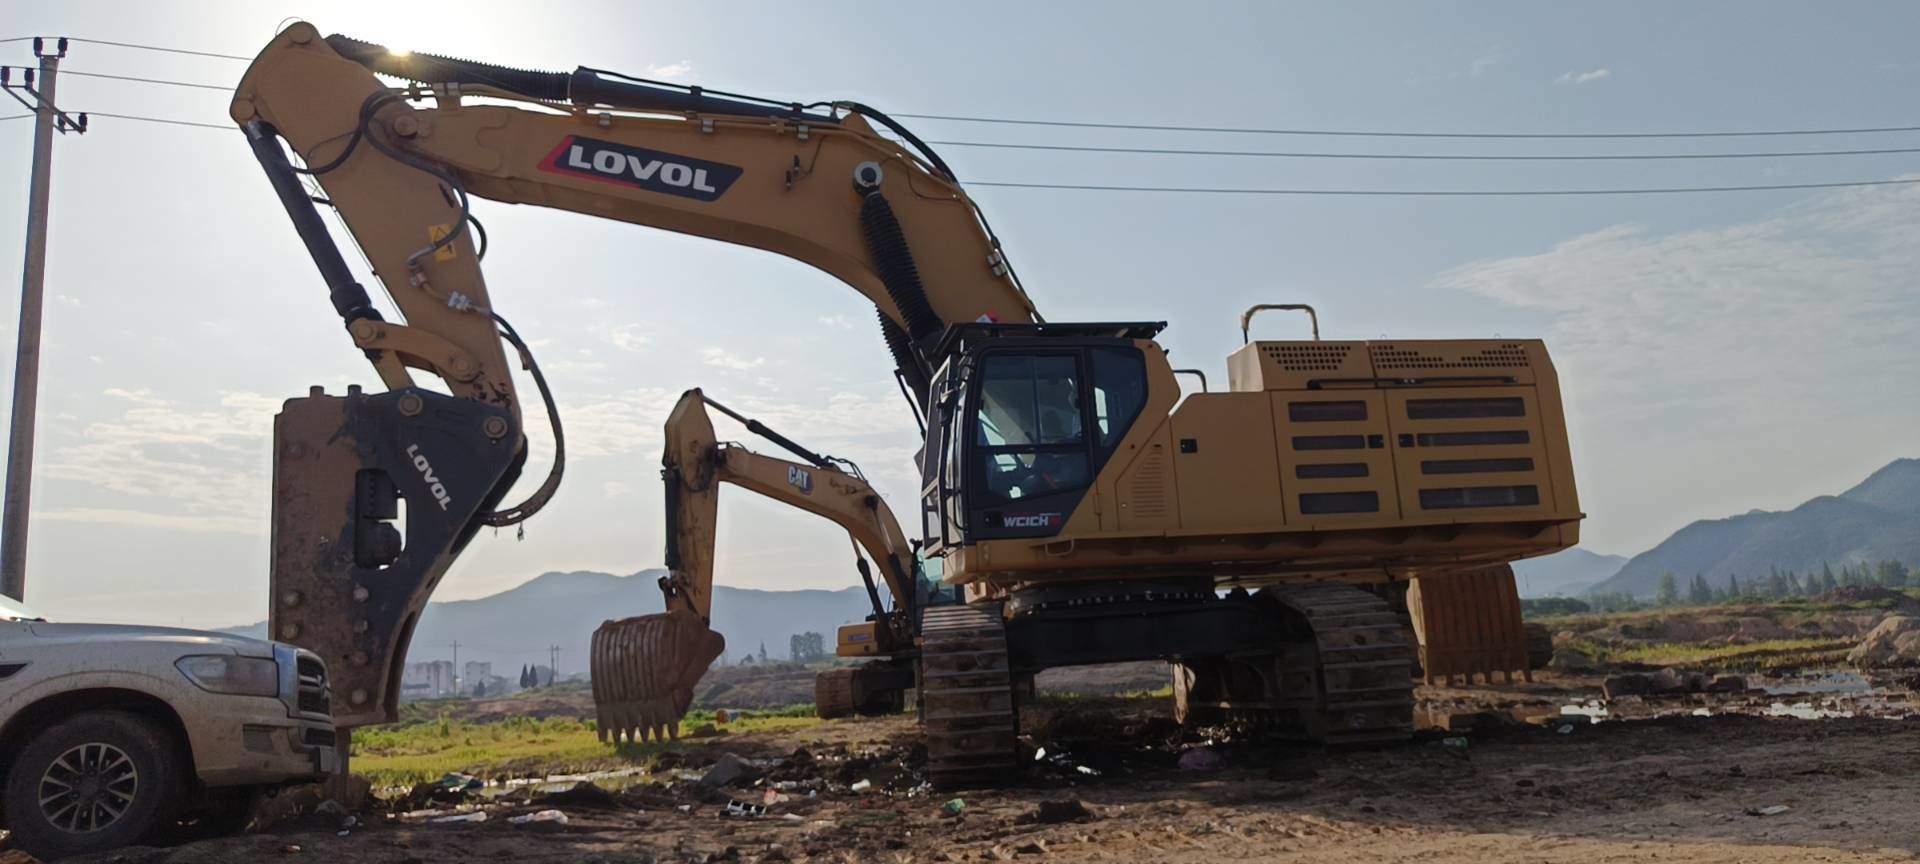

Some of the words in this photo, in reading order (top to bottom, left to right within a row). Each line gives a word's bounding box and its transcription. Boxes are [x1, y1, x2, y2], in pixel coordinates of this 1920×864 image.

[568, 145, 716, 193] LOVOL
[406, 444, 451, 511] LOVOL
[788, 465, 809, 489] CAT
